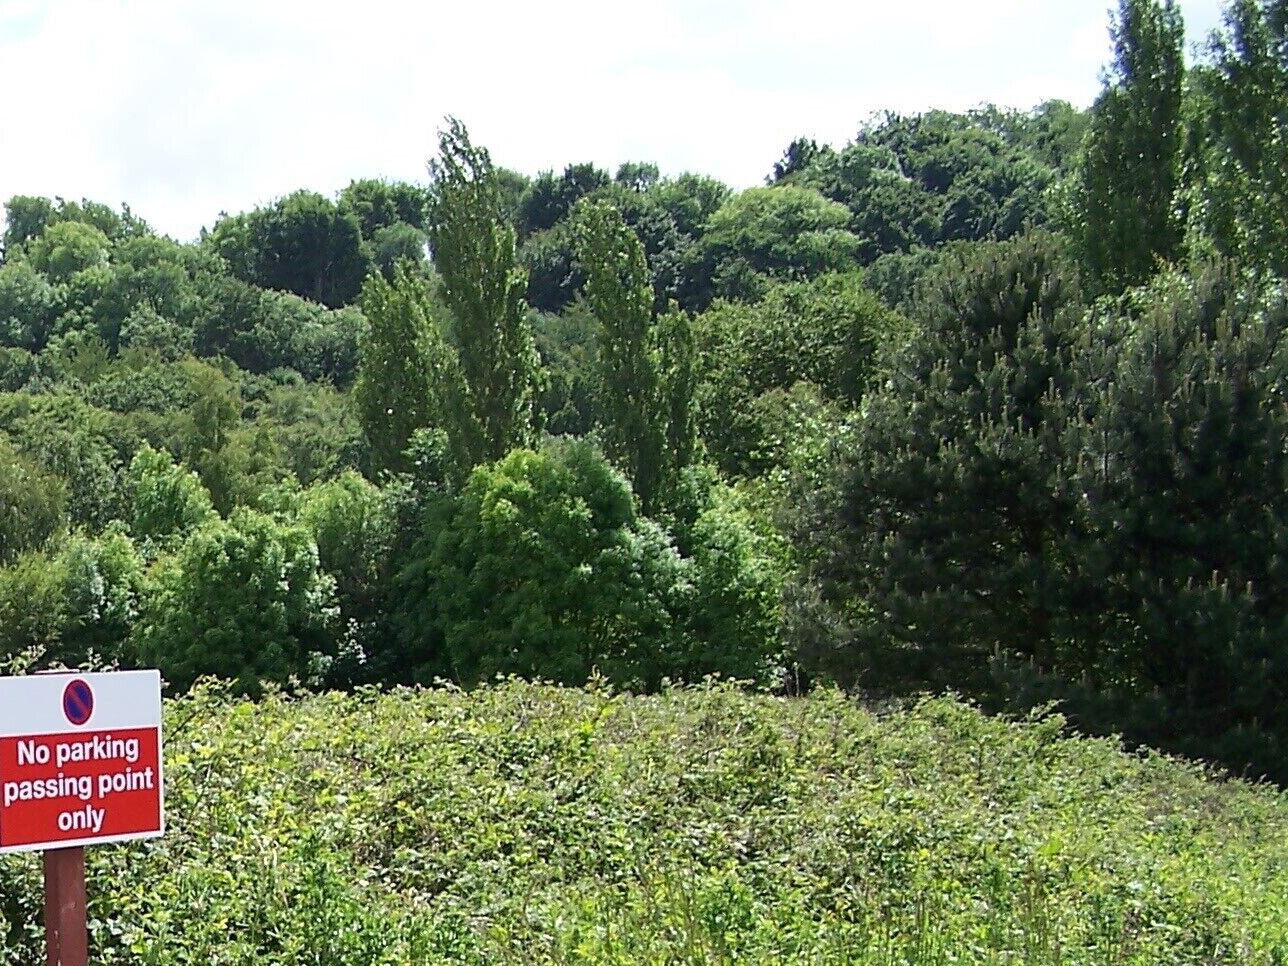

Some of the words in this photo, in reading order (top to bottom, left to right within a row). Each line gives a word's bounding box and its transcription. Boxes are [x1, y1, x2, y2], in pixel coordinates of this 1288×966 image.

[17, 739, 50, 765] No
[56, 735, 140, 768] parking
[4, 772, 92, 807] passing
[98, 766, 154, 798] point
[57, 804, 106, 833] only
